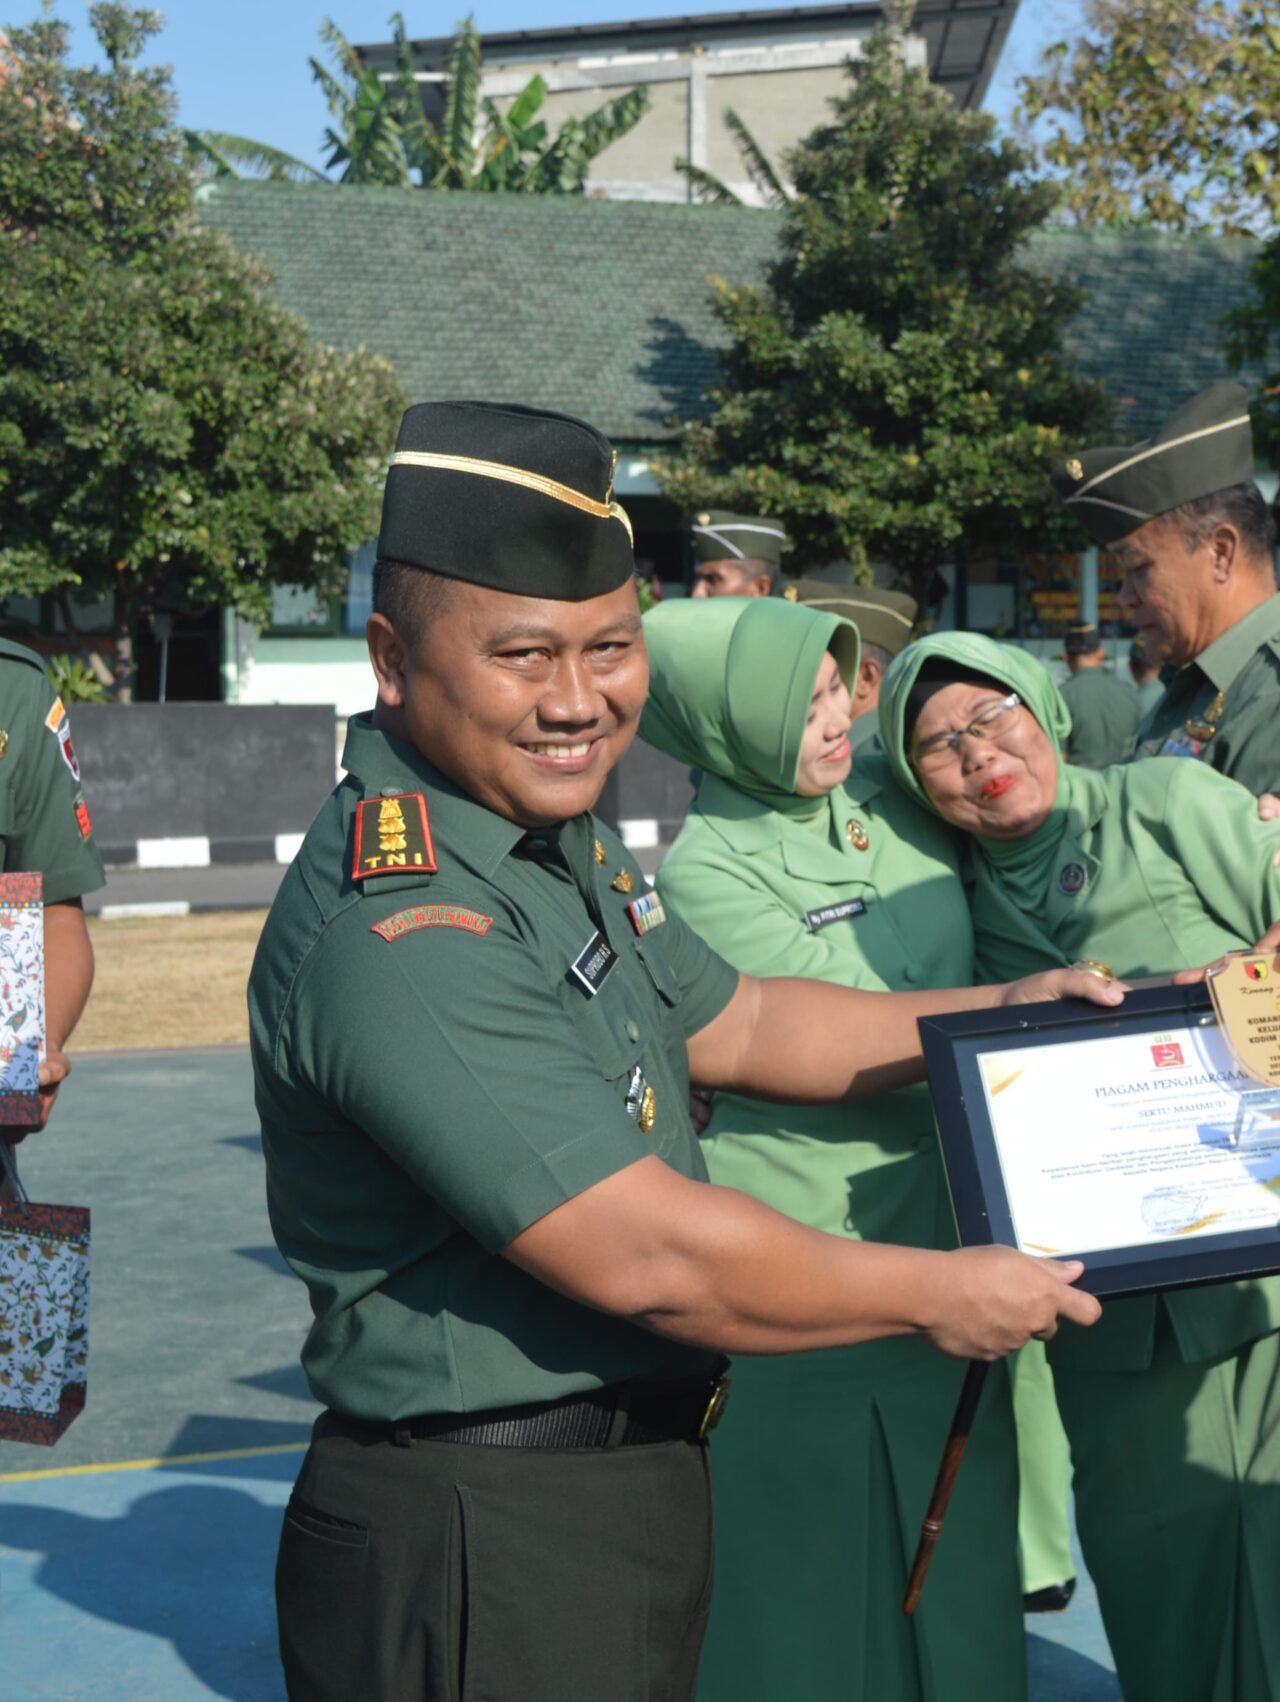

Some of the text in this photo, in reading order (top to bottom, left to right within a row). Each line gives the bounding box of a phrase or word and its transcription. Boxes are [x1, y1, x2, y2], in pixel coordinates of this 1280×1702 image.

[364, 853, 423, 868] TNI
[1248, 1034, 1277, 1044] KODIM
[1094, 1081, 1150, 1098] PIAGAM
[1138, 1107, 1171, 1118] SERTU
